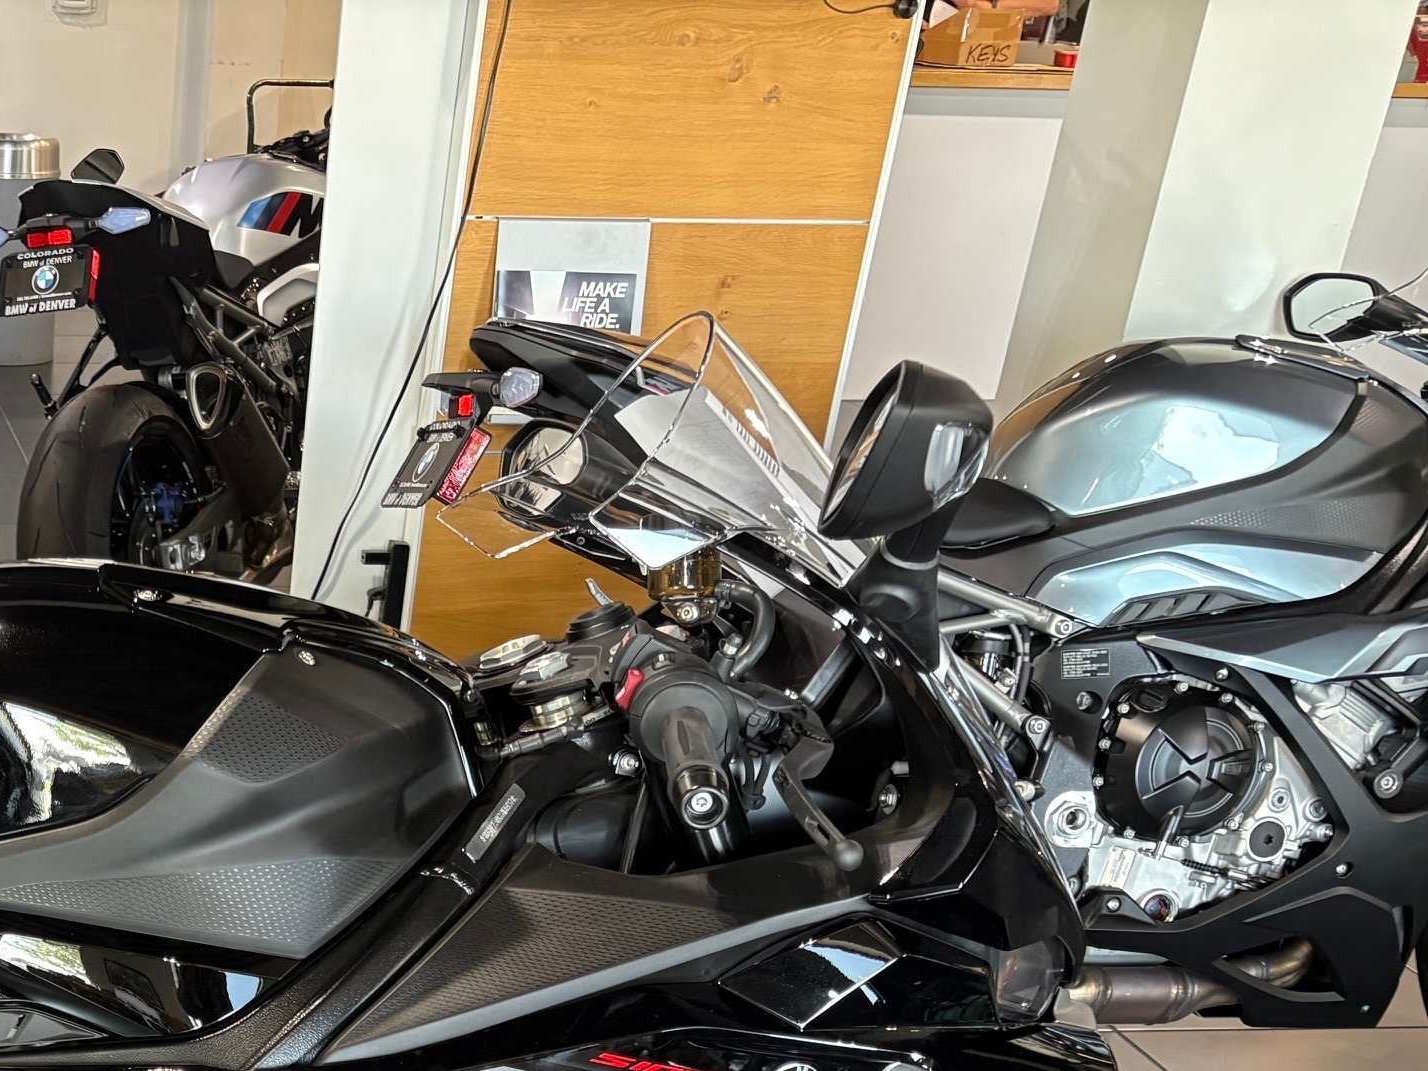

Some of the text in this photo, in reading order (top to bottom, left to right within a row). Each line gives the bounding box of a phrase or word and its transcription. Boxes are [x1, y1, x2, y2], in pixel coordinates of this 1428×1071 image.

[966, 43, 1011, 64] KEYS
[17, 247, 74, 260] COLORADO
[23, 260, 38, 269] BMW
[46, 256, 73, 265] DENVER
[579, 281, 629, 298] MAKE
[5, 298, 77, 316] BMW of DENVER
[562, 297, 610, 313] LIFE A
[580, 313, 620, 329] RIDE.
